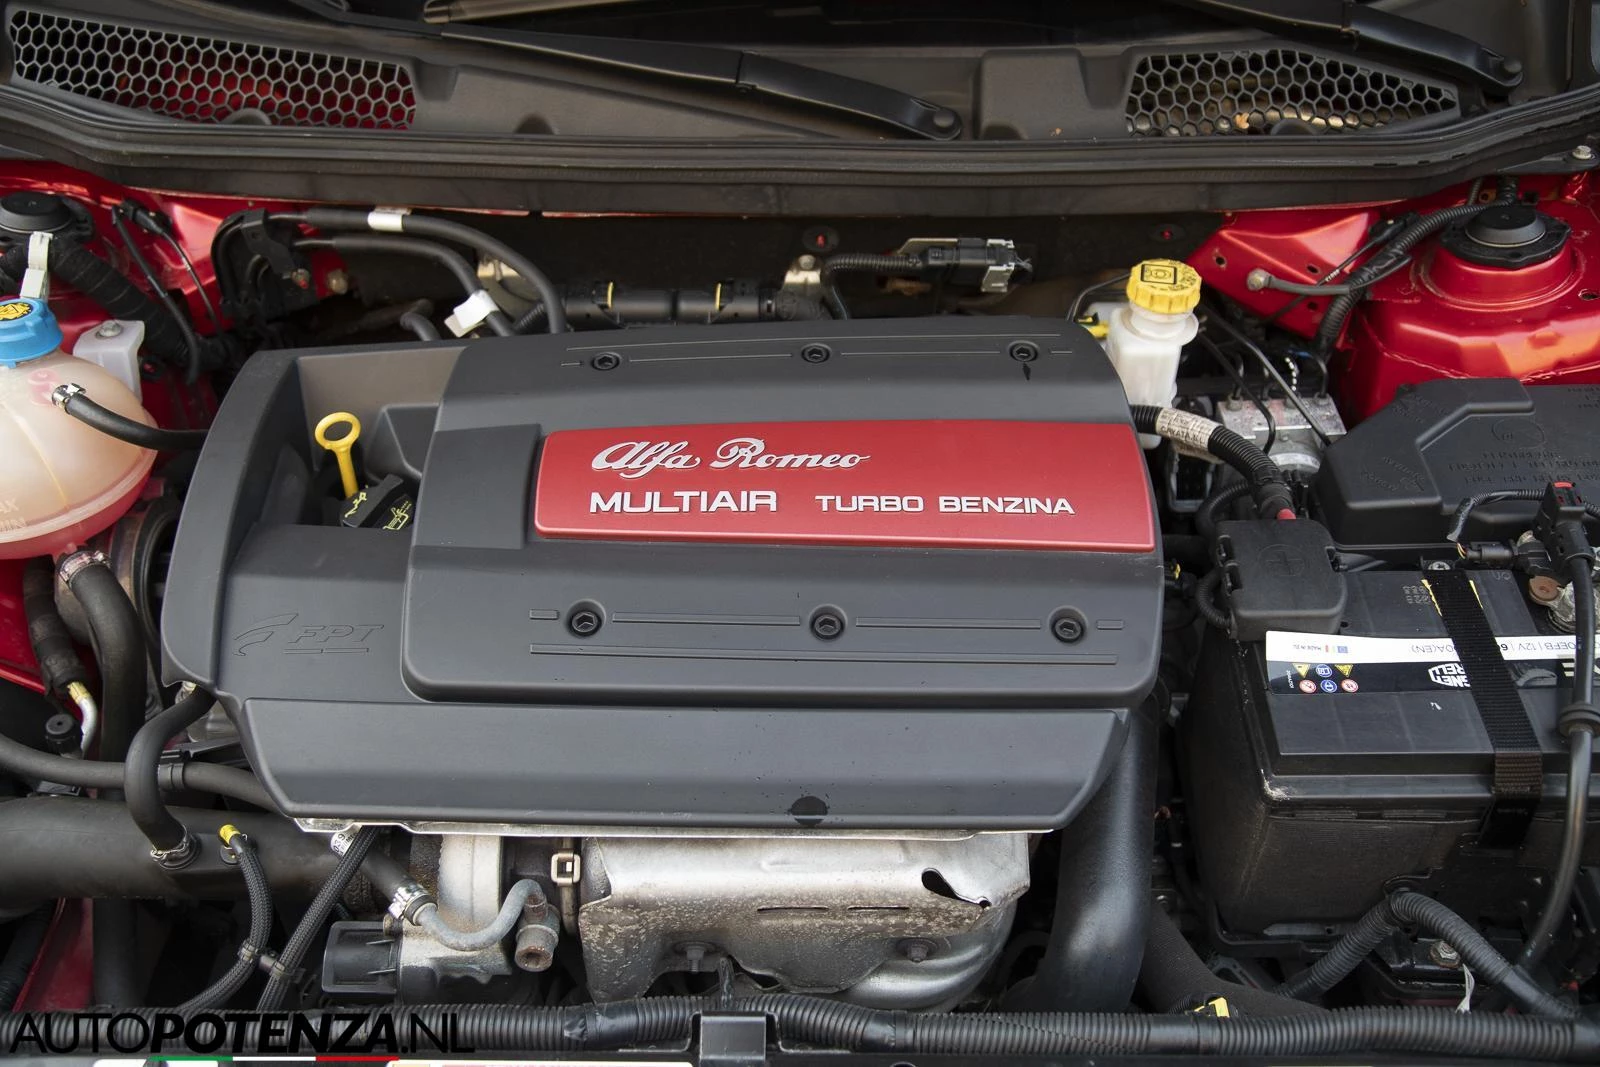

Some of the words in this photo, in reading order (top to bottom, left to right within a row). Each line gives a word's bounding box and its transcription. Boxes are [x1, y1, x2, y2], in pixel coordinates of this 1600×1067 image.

[591, 440, 701, 479] Alfa
[709, 437, 871, 469] Romeo
[589, 490, 776, 513] MULTIAIR
[815, 495, 924, 512] TURBO
[939, 496, 1075, 514] BENZINA
[287, 624, 385, 644] FPT
